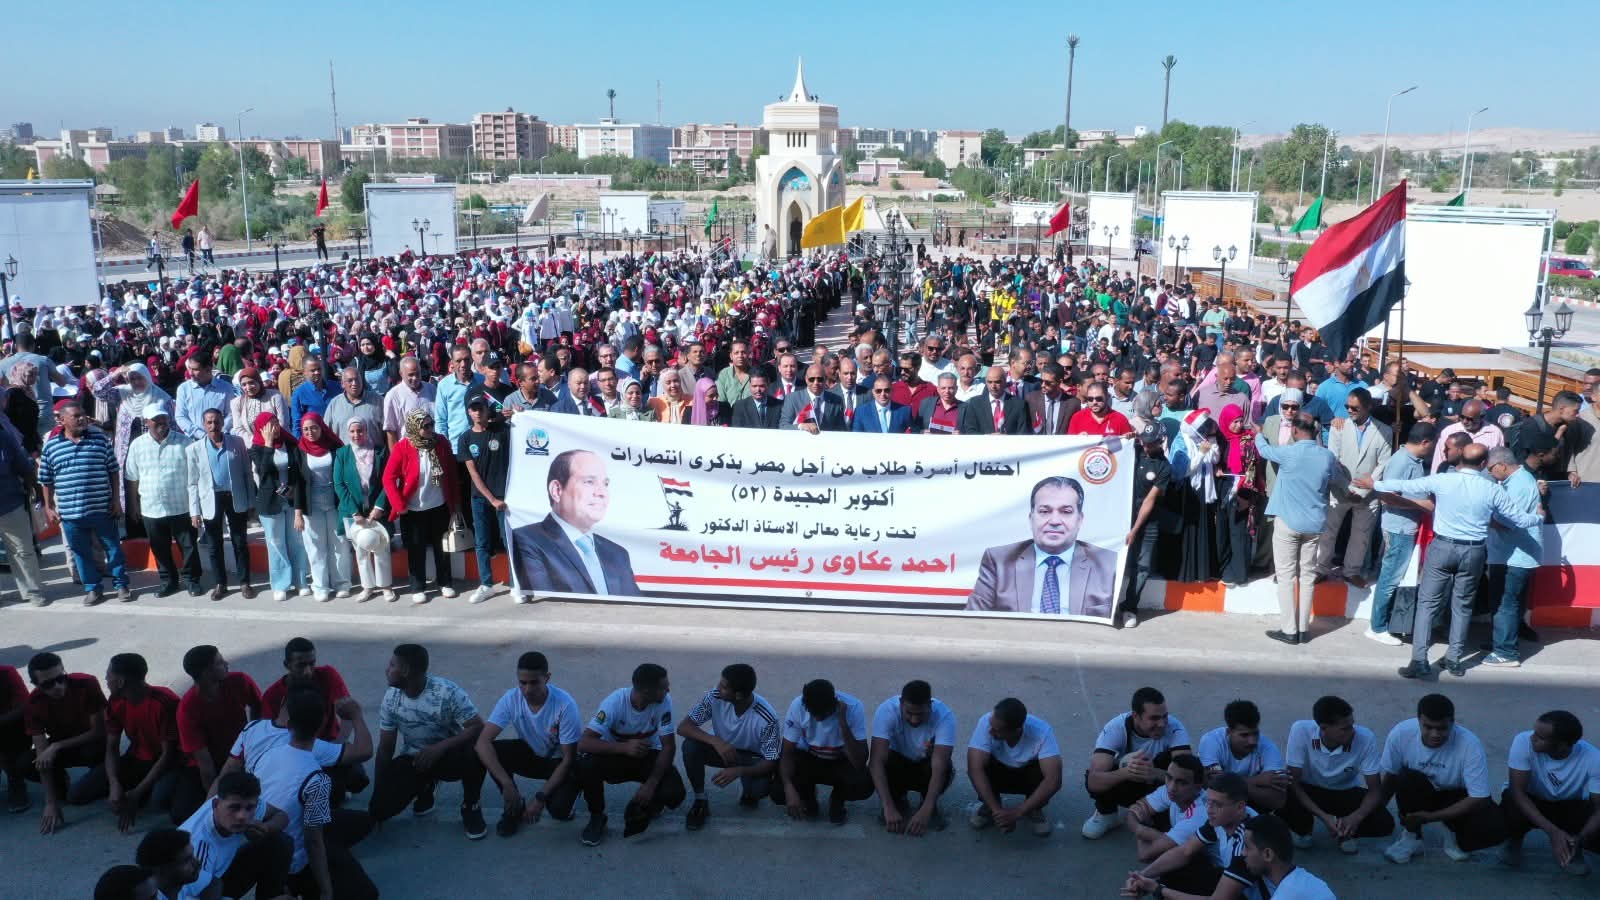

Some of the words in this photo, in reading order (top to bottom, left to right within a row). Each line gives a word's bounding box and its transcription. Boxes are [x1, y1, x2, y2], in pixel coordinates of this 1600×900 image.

[610, 446, 683, 467] انتصارات
[688, 452, 743, 474] بذكرى
[791, 455, 825, 477] أجل
[747, 460, 786, 476] مصر
[831, 462, 855, 477] من
[862, 459, 907, 478] طلاب
[914, 458, 959, 479] أسرة
[963, 459, 1021, 480] احتفال
[731, 483, 767, 504] (٥٢)
[773, 486, 838, 508] المجيدة
[842, 487, 894, 511] أكتوبر
[699, 517, 749, 535] الدكتور
[752, 518, 799, 535] الاستاذ
[802, 519, 840, 540] معالى
[845, 523, 881, 542] رعاية
[885, 526, 917, 540] تحت
[659, 540, 742, 569] الجامعة
[749, 547, 816, 576] رئيس
[822, 549, 893, 576] عكاوى
[901, 553, 956, 574] احمد
